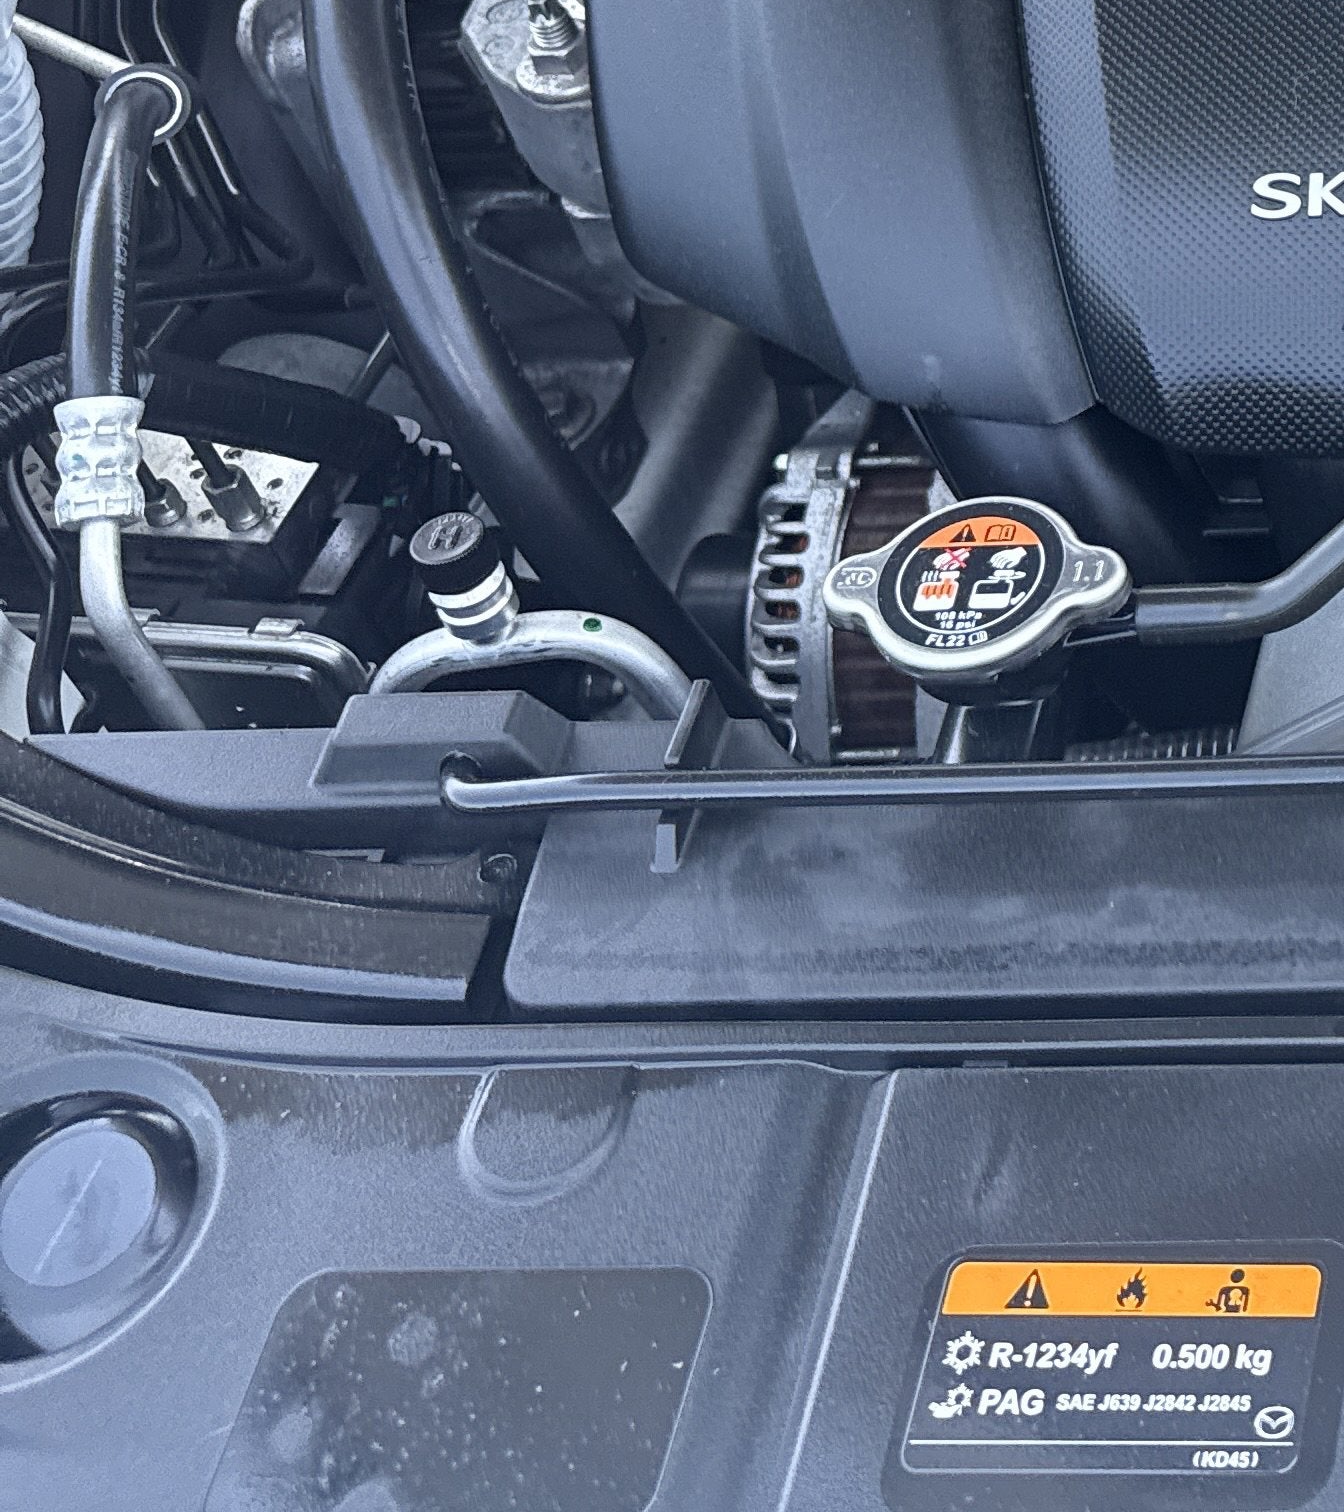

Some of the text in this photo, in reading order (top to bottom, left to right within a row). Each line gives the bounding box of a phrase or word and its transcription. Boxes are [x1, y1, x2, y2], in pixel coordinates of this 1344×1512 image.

[1072, 559, 1106, 584] 1.1
[934, 610, 983, 621] 108 kPa
[954, 619, 977, 630] psi
[924, 633, 966, 648] FL22
[988, 1341, 1273, 1376] R-1234yf 0.500 kg
[977, 1389, 1252, 1416] PAG SAE J639 J2842 J2845
[1192, 1450, 1259, 1469] (KD45)
